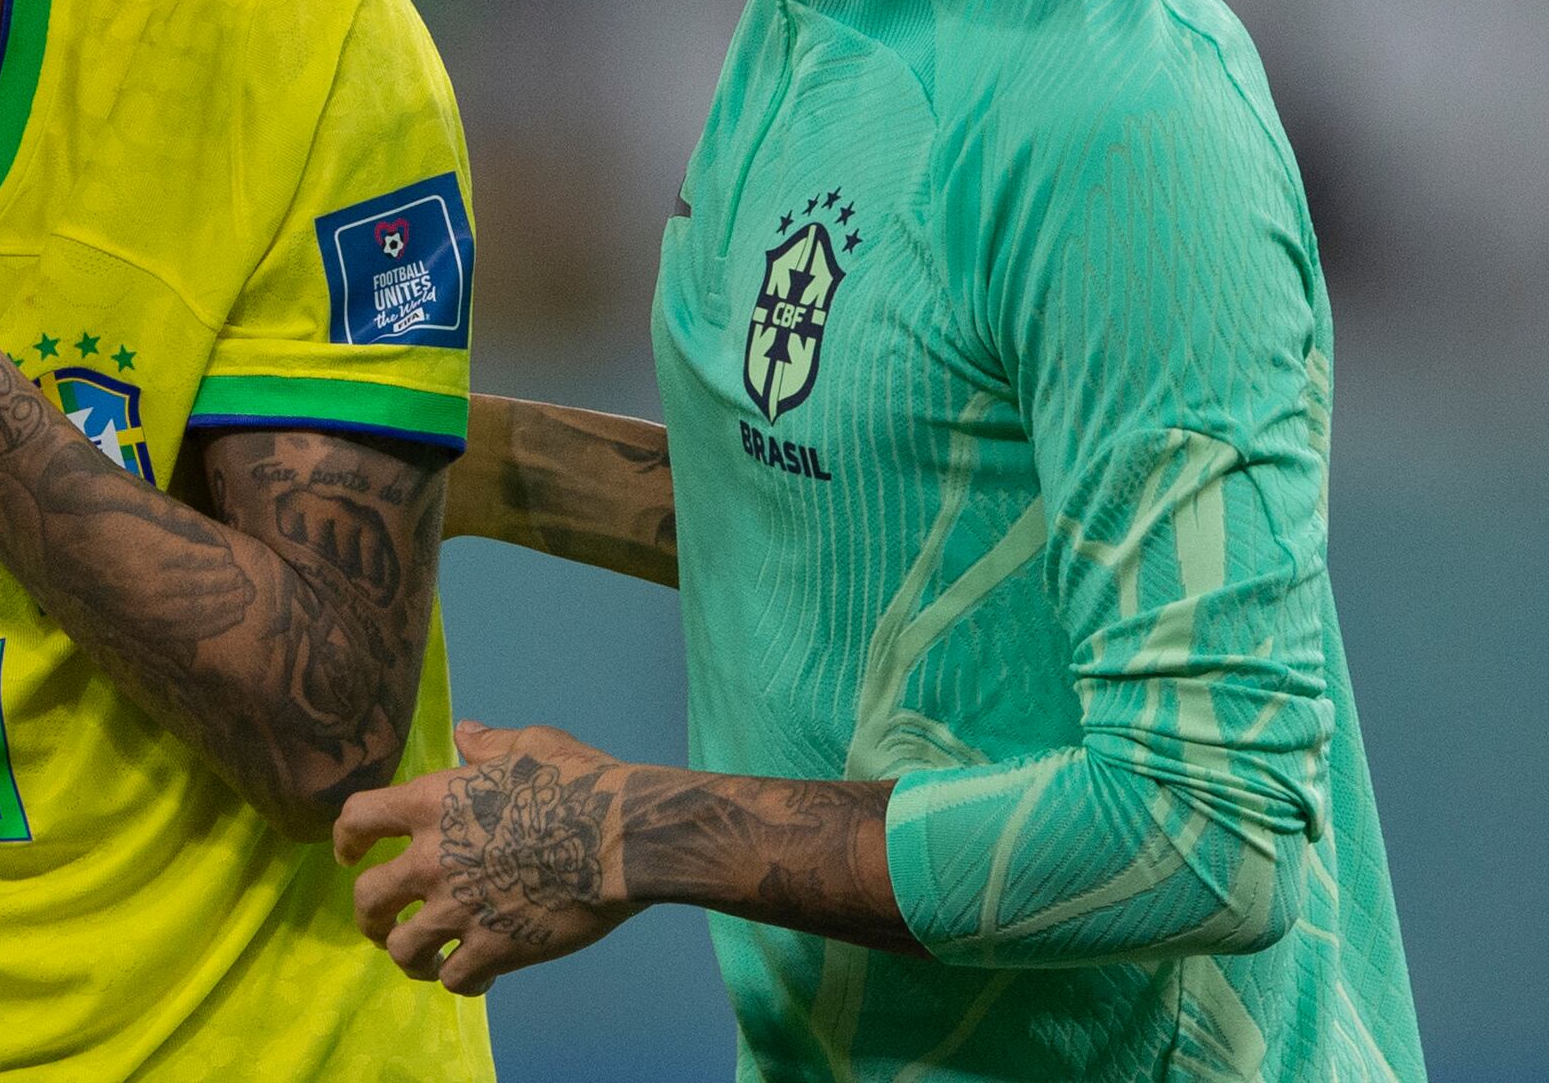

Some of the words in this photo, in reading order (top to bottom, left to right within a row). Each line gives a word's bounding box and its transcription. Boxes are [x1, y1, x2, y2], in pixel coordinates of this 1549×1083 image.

[373, 260, 429, 290] FOOTBALL
[374, 275, 432, 311] UNITES
[374, 312, 398, 329] the
[398, 286, 437, 318] World
[396, 311, 421, 330] FIFA
[772, 302, 807, 329] CBF
[739, 419, 832, 481] BRASIL
